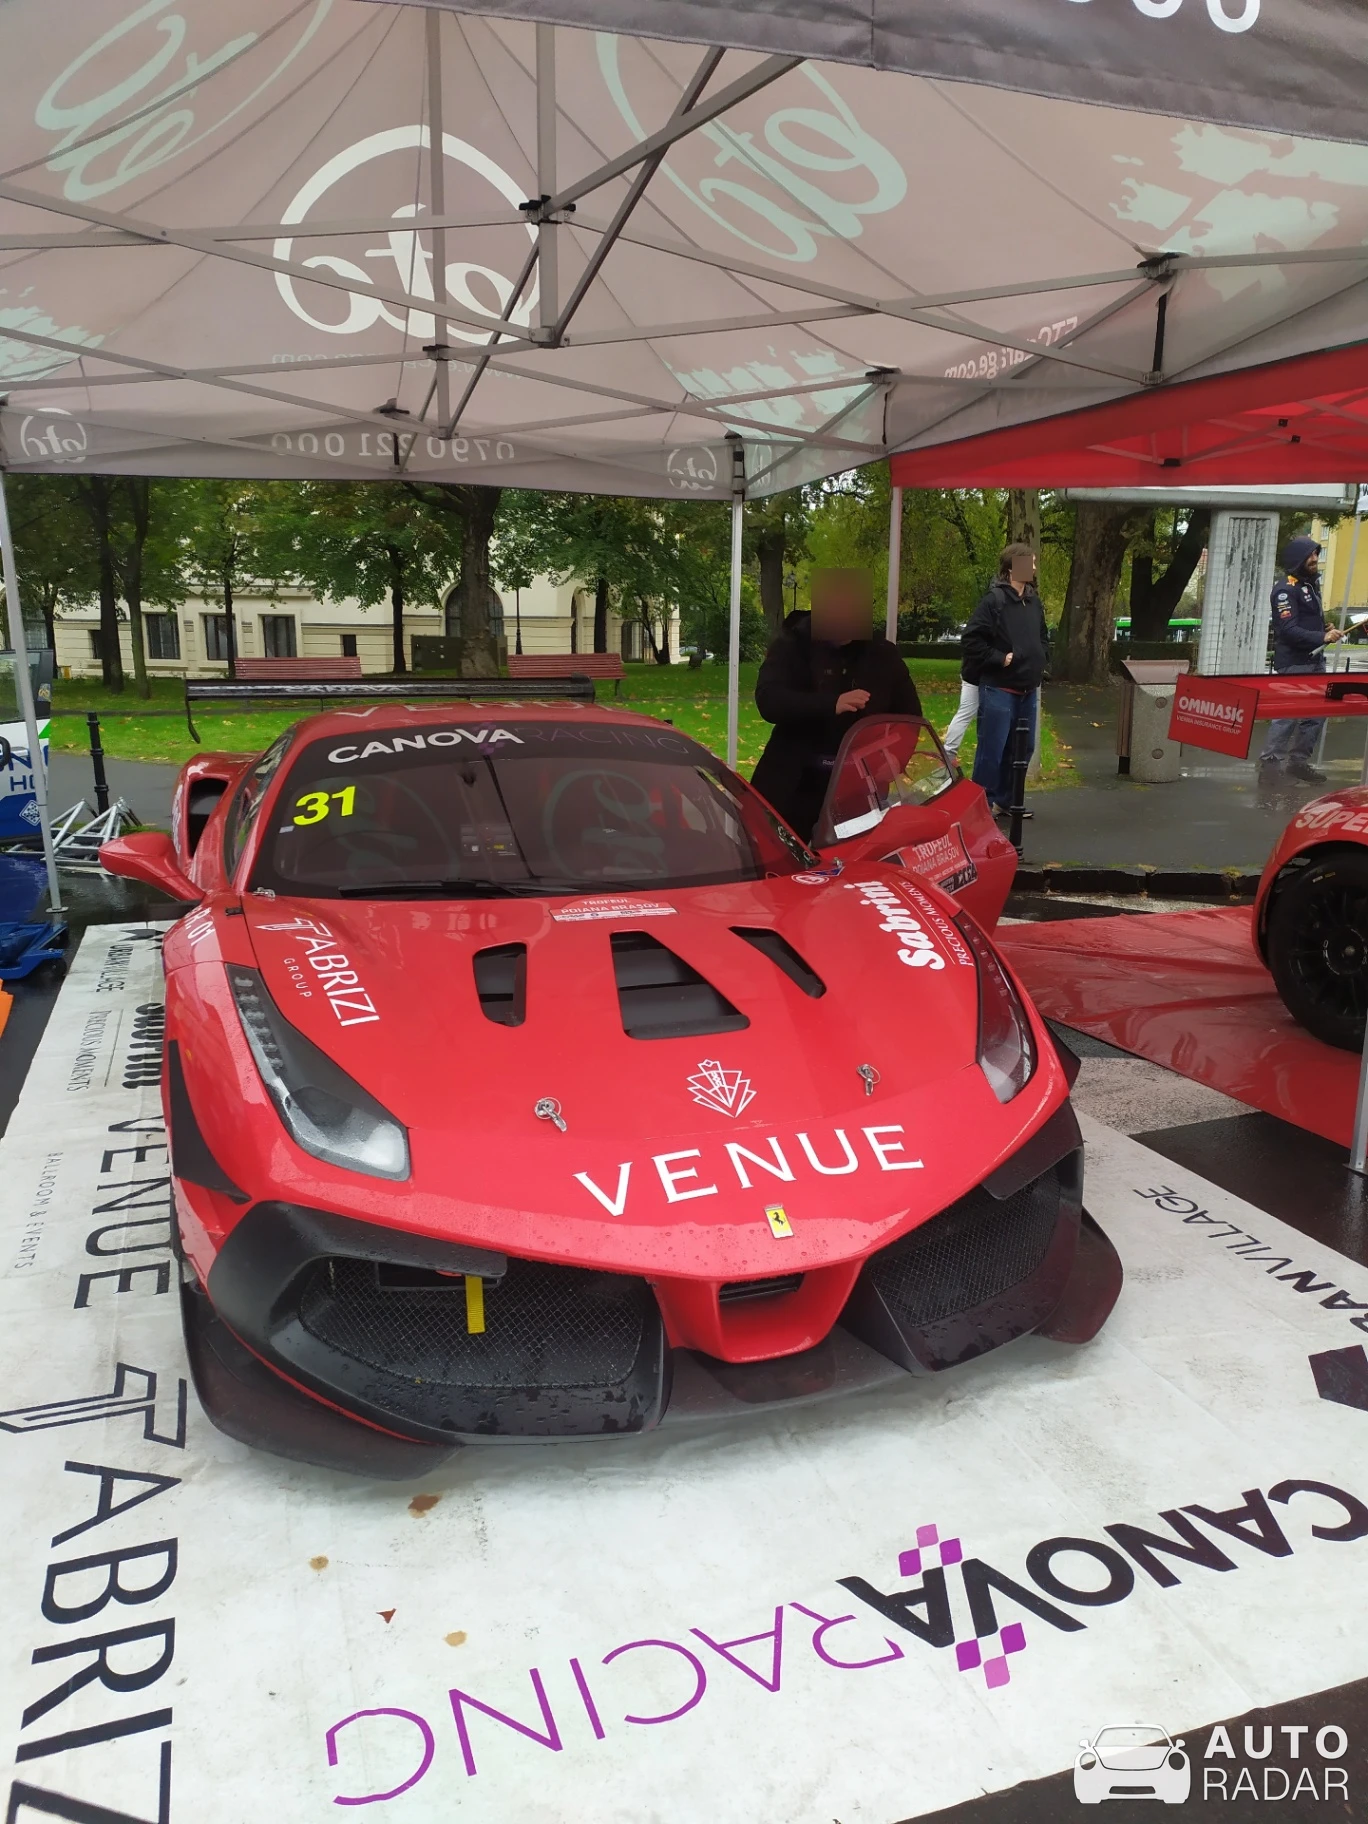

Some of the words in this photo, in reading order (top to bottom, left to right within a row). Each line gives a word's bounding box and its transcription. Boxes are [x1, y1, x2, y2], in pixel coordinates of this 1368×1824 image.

[1178, 696, 1245, 723] OMNIASIG
[1193, 718, 1222, 732] INSURANCE
[1223, 725, 1242, 735] GROUP
[327, 727, 525, 764] CANOVA
[515, 727, 689, 754] RACING
[292, 785, 356, 826] 31
[560, 905, 609, 914] POIANA
[900, 881, 937, 917] MOMENTS
[843, 881, 946, 970] Sabrini
[931, 917, 975, 968] PRECIOUS
[283, 957, 313, 998] GROUP
[80, 1010, 112, 1046] PRECIOUS
[66, 1047, 101, 1092] MOMENTS
[32, 1152, 64, 1206] BALLROOM
[572, 1125, 925, 1217] VENUE
[73, 1113, 172, 1310] VENUE
[14, 1222, 44, 1270] EVENTS
[835, 1479, 1368, 1649] CANOVA
[326, 1601, 905, 1806] RACING
